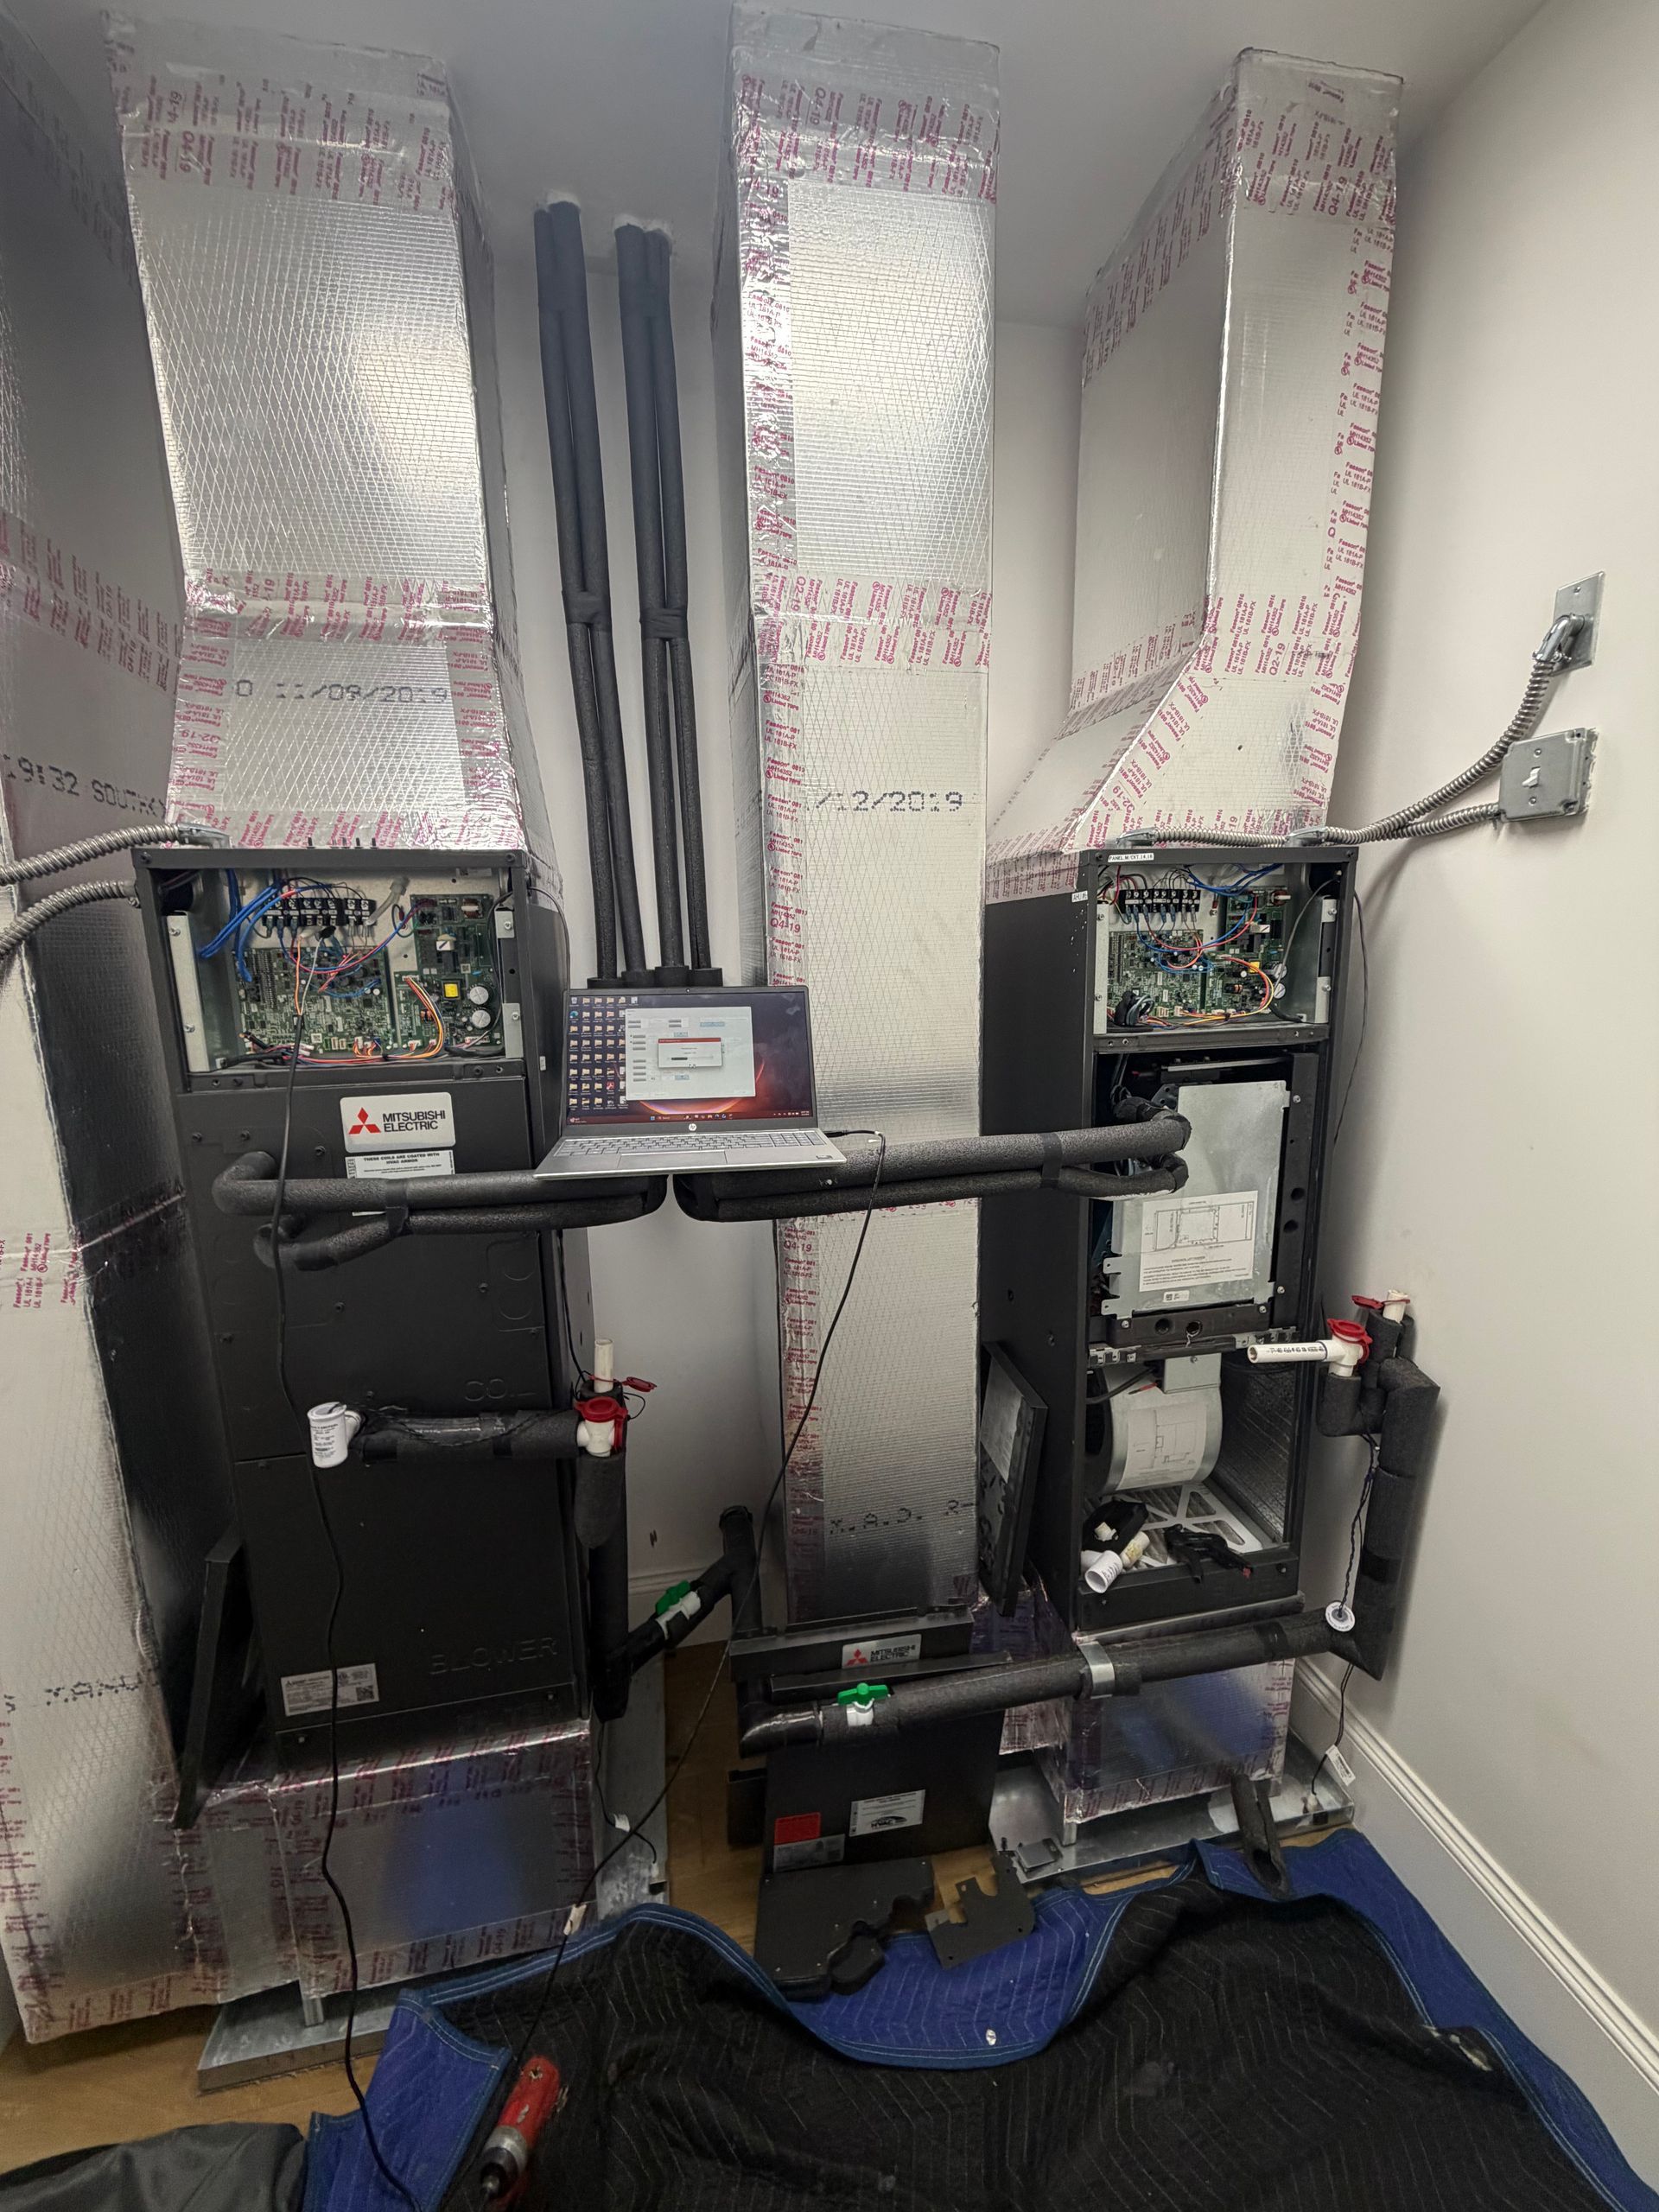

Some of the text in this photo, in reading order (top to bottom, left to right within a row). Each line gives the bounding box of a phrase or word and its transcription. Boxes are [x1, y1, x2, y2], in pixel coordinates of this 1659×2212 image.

[1328, 175, 1347, 216] Q4-19
[791, 576, 805, 611] Q2-19
[855, 654, 861, 663] UL
[1269, 643, 1286, 675] Q2-19
[771, 918, 800, 933] Q4-19
[383, 1110, 446, 1122] MITSUBISHI
[384, 1121, 438, 1132] ELECTRIC
[783, 1241, 812, 1252] Q4-19
[871, 1645, 915, 1655] MITSUBISHI
[871, 1651, 908, 1662] ELECTRIC
